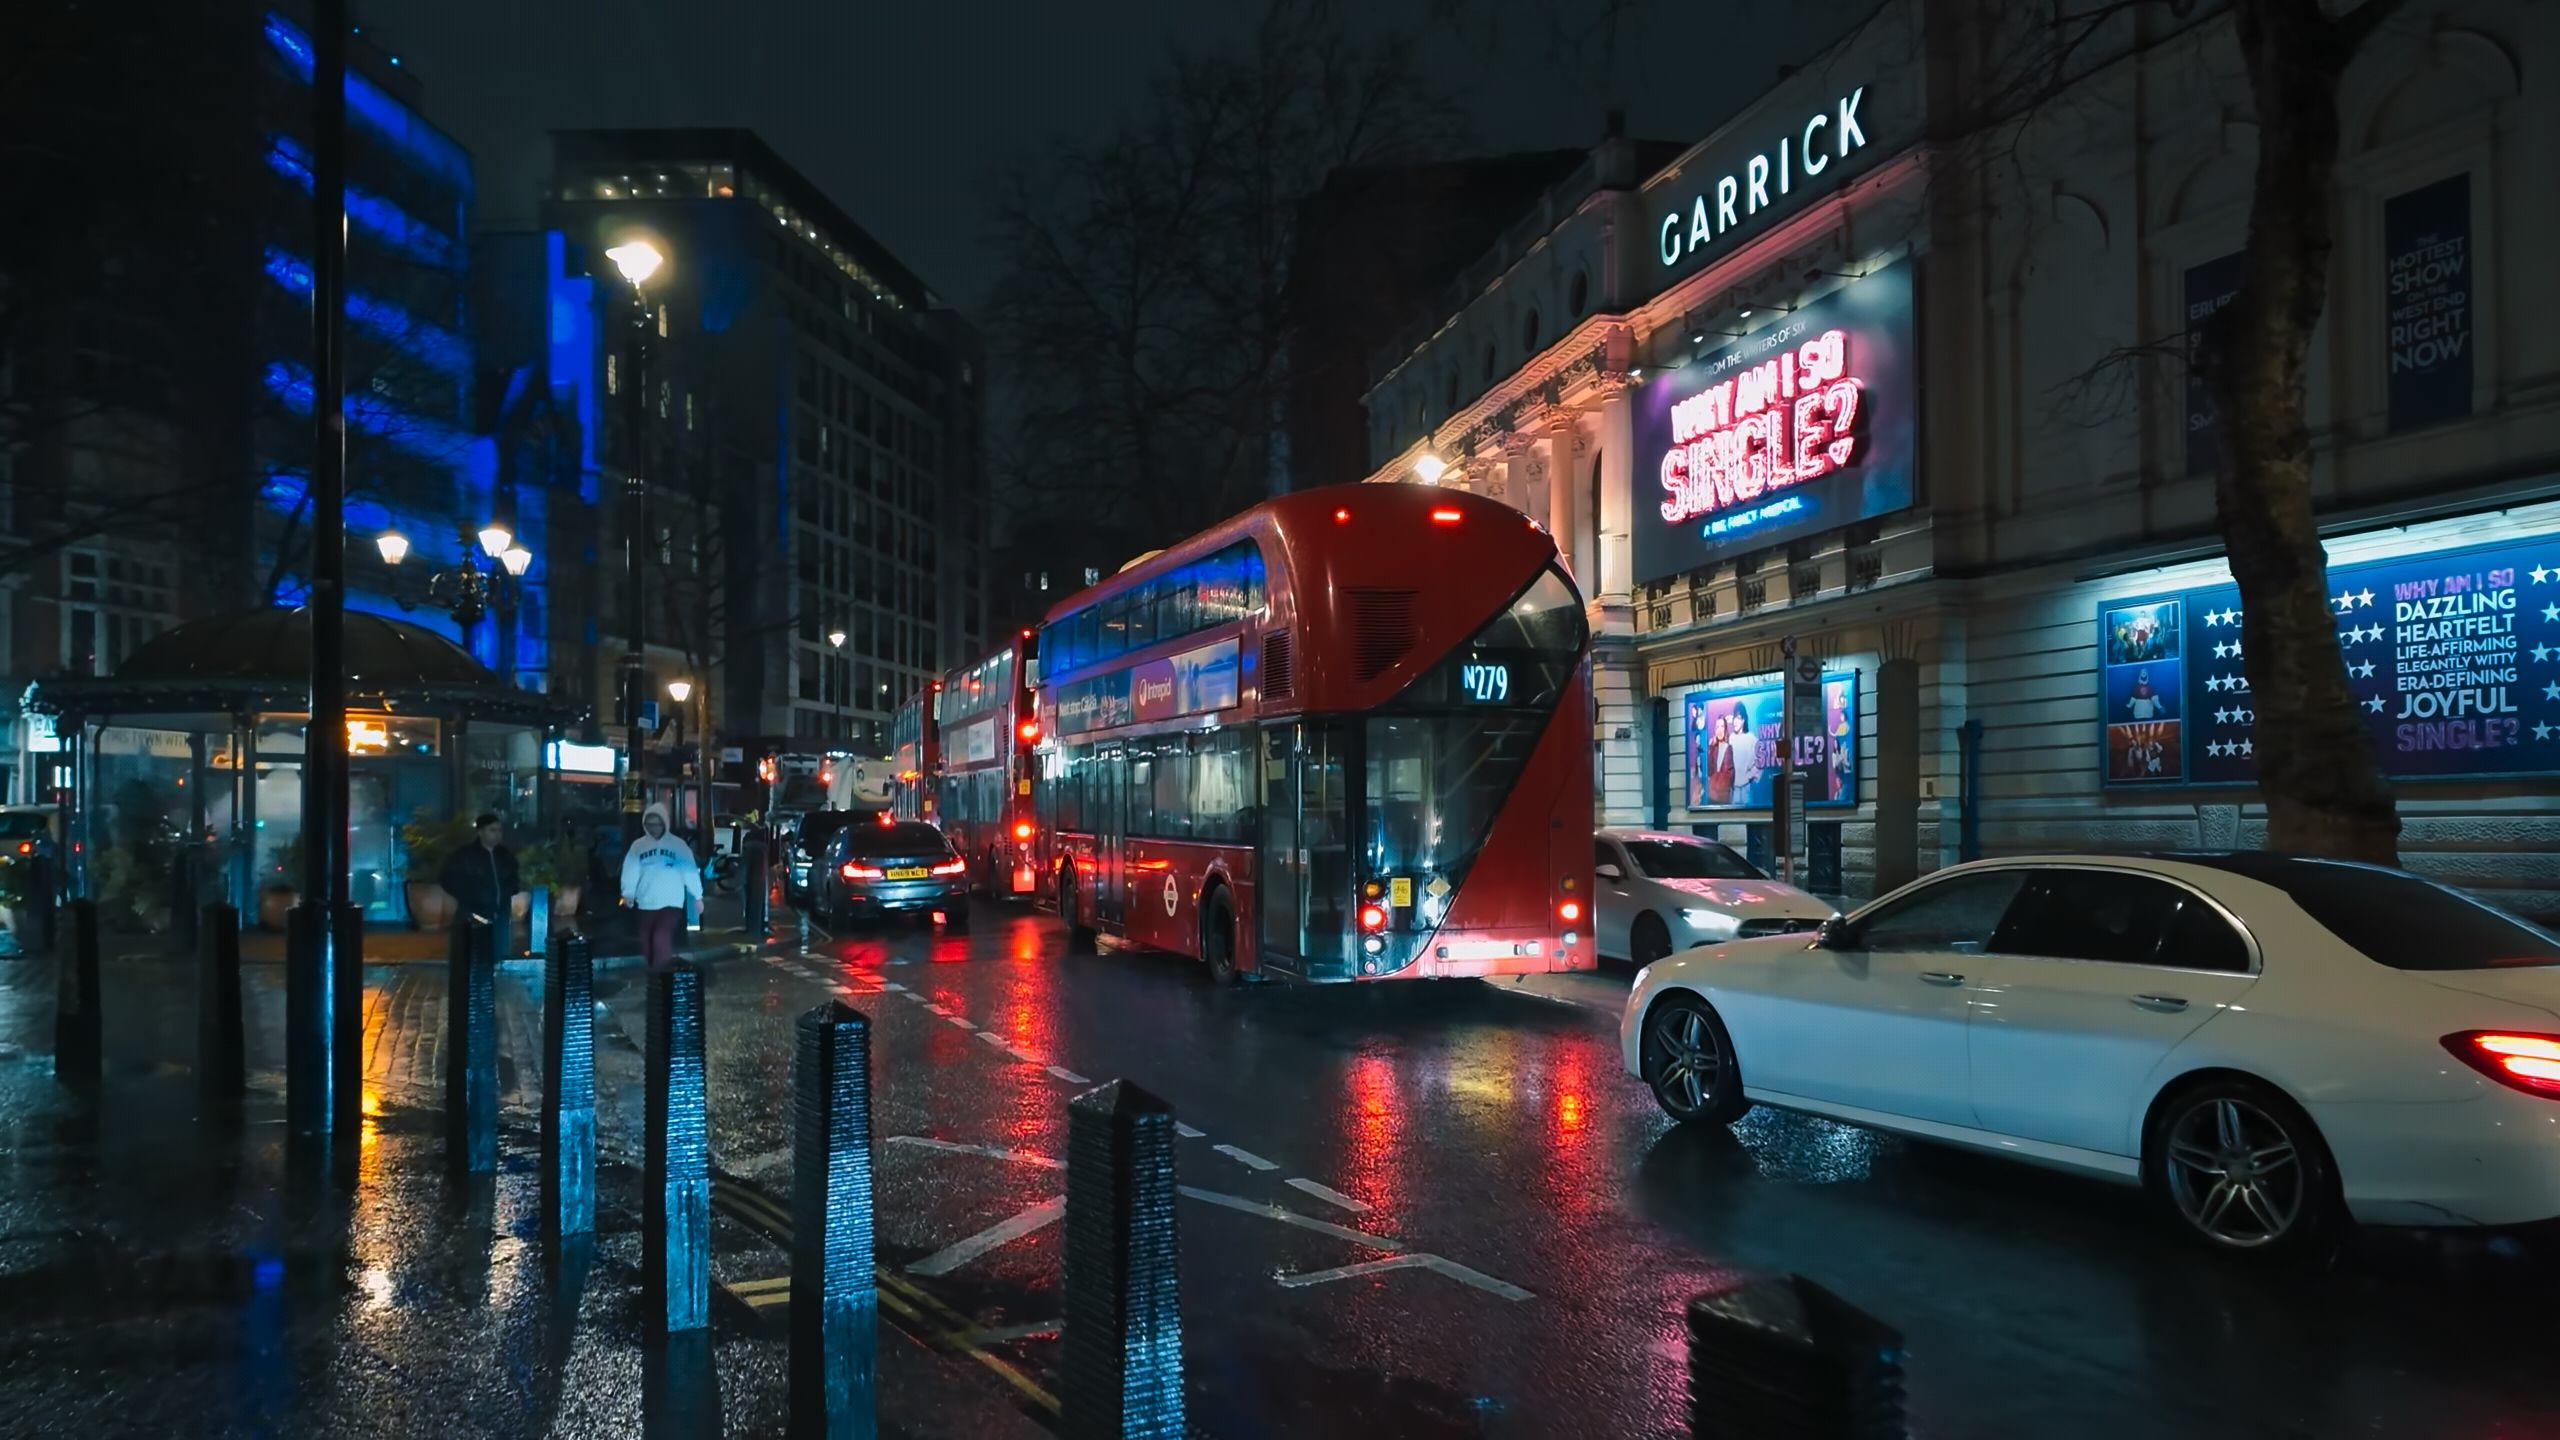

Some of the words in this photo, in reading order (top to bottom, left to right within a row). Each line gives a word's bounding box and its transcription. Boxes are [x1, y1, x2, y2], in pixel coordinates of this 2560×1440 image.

[1661, 86, 1866, 266] GARRICK
[2390, 236, 2465, 274] HOTTEST
[2391, 255, 2465, 295] SHOW
[2392, 300, 2431, 321] WEST
[2433, 291, 2466, 311] END
[2391, 307, 2465, 348] RIGHT
[1704, 358, 1726, 378] FROM
[1727, 351, 1742, 368] THE
[1743, 334, 1777, 360] WRITERS
[1778, 327, 1791, 343] OF
[1792, 320, 1807, 337] SIX
[1671, 379, 1734, 444] WHY
[1735, 360, 1778, 417] AM
[1781, 353, 1795, 398] I
[1799, 330, 1846, 390] SO
[1661, 378, 1861, 522] SINGLE?
[2394, 578, 2439, 602] WHY
[2444, 573, 2472, 595] AM
[2476, 572, 2483, 591] I
[2488, 567, 2515, 588] SO
[2396, 588, 2517, 623] DAZZLING
[2396, 613, 2516, 643] HEARTFELT
[2397, 635, 2517, 660] LIFE-AFFIRMING
[2397, 656, 2471, 674] ELEGANTLY
[2475, 651, 2517, 667] WITTY
[1147, 677, 1172, 702] Intrepid
[1463, 665, 1508, 700] N279
[2397, 667, 2518, 692] ERA-DEFINING
[2397, 686, 2518, 719] JOYFUL
[1759, 722, 1781, 739] WHY
[2397, 717, 2520, 752] SINGLE?
[1755, 735, 1826, 770] SINLE?
